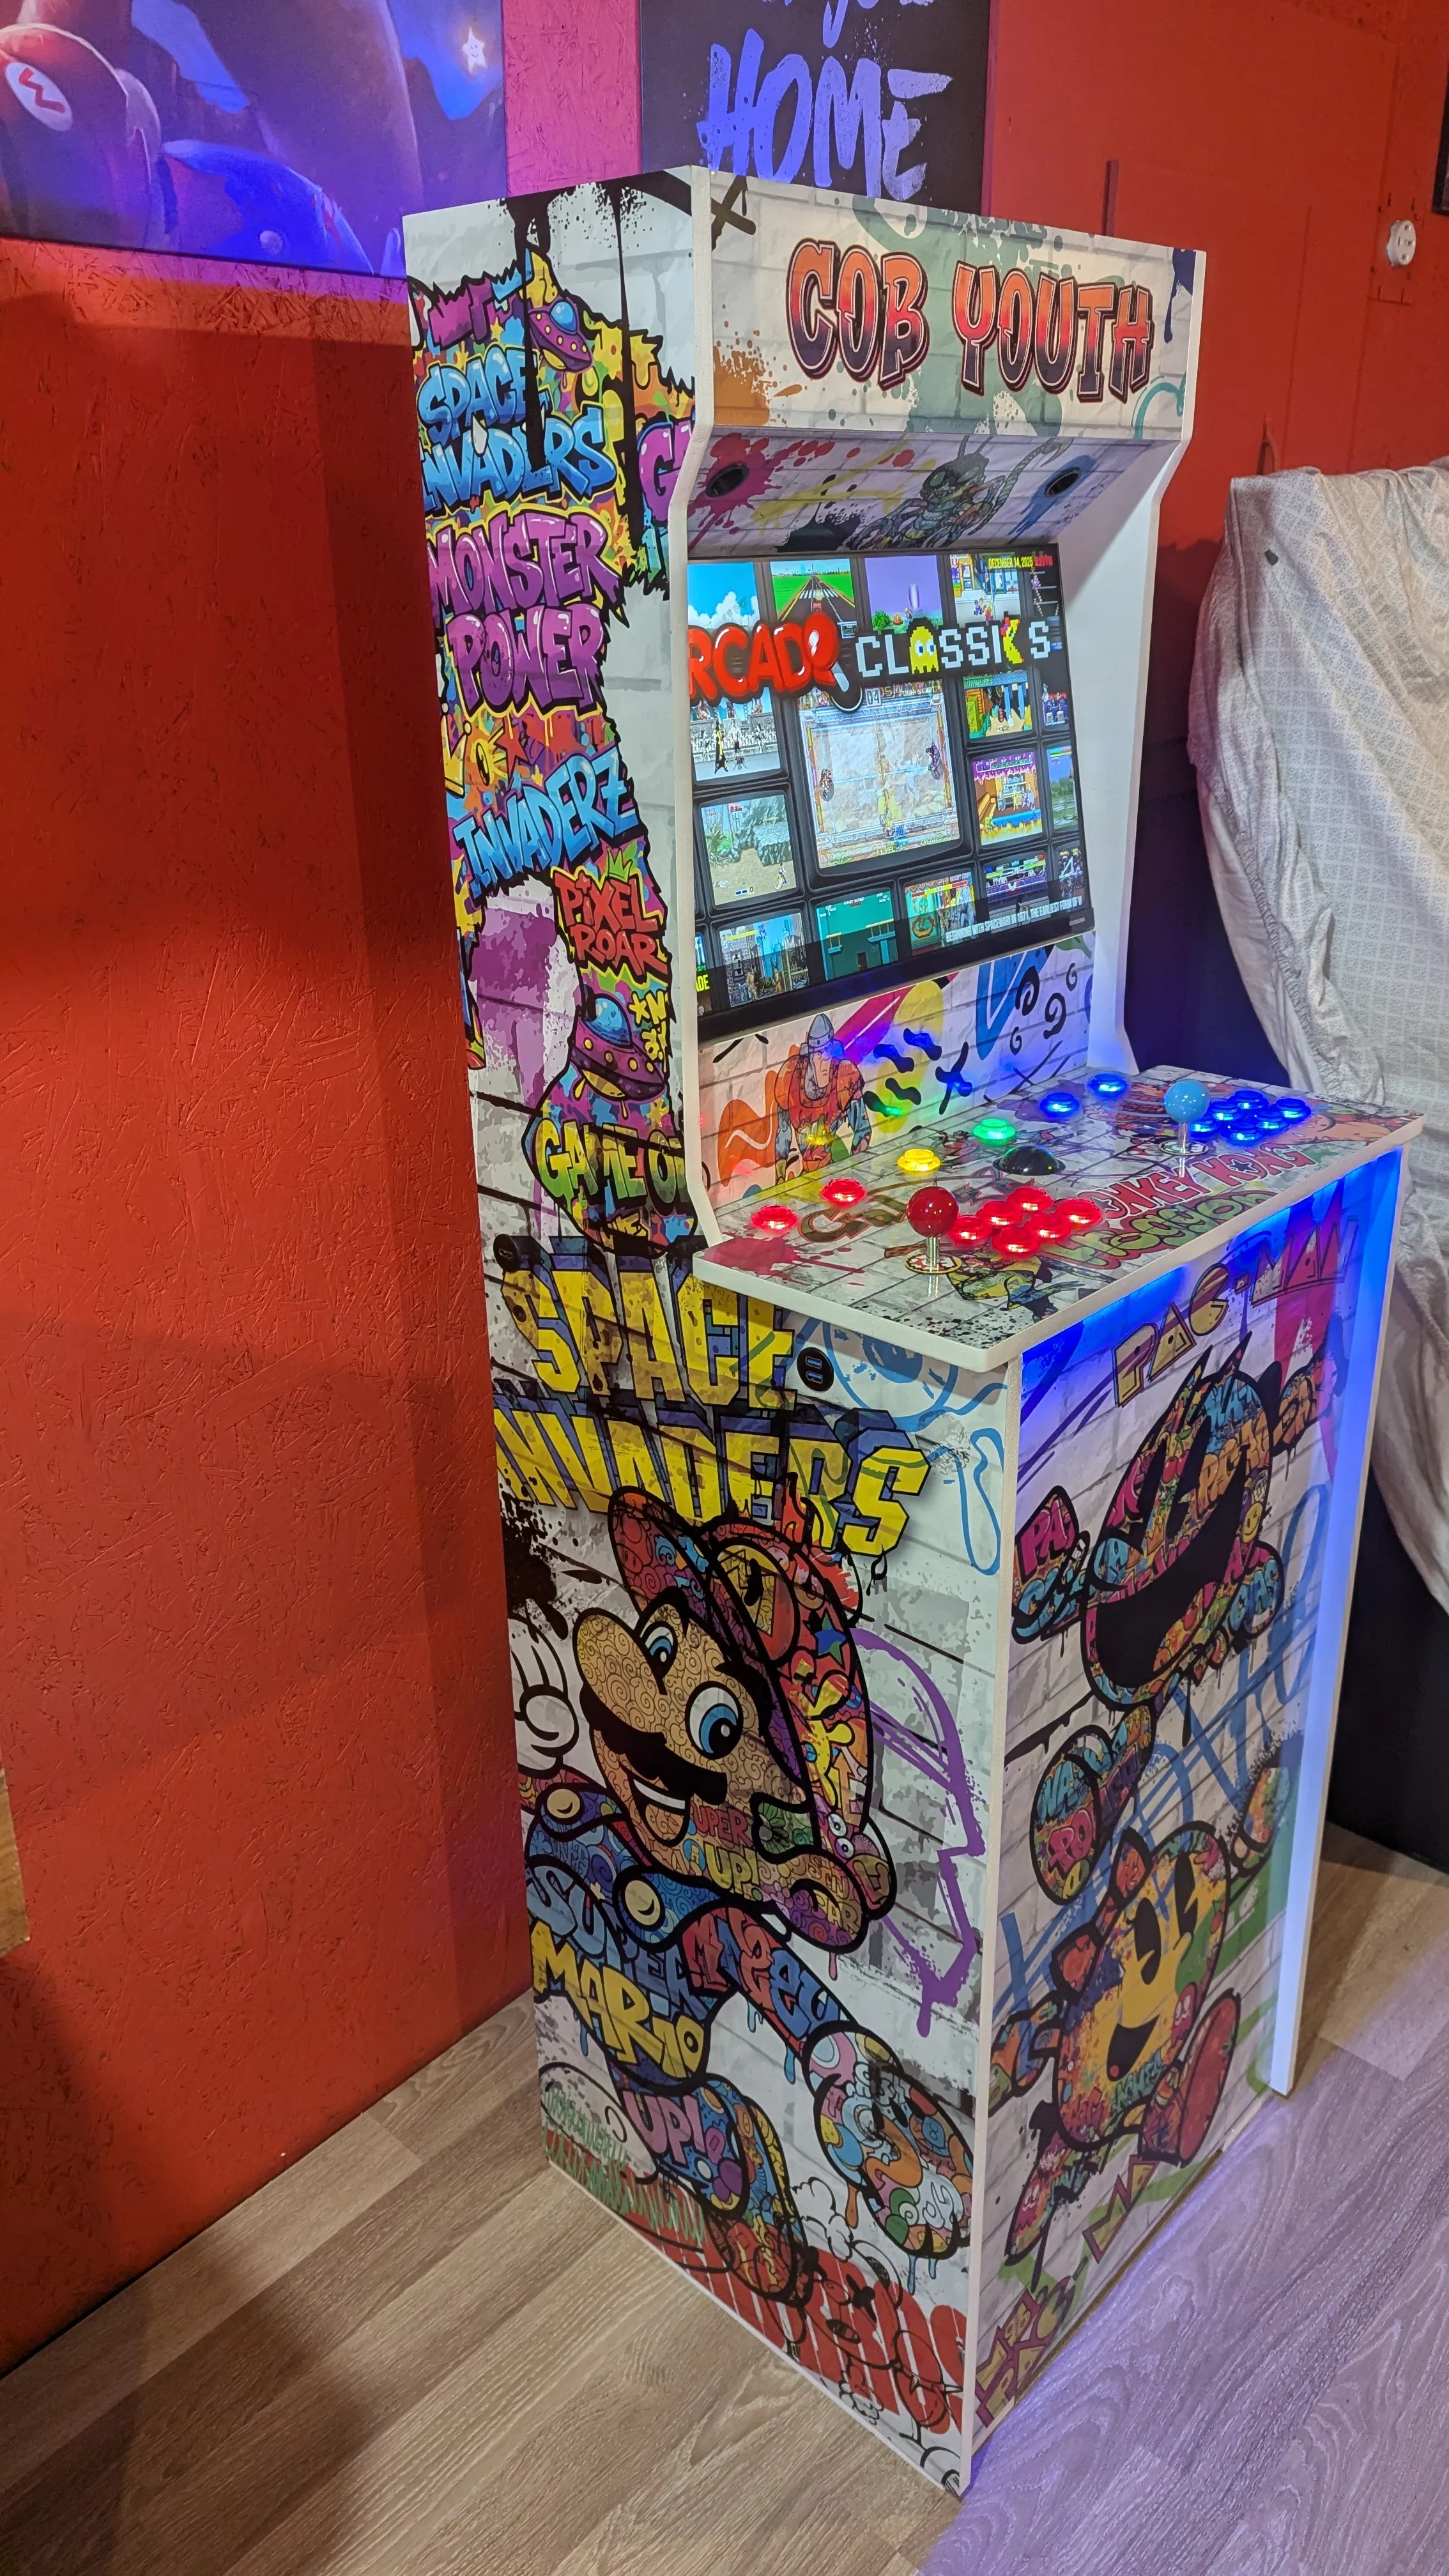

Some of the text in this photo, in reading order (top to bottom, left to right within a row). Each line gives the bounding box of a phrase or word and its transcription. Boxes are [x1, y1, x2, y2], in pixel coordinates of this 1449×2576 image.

[697, 29, 953, 201] HOME
[786, 238, 1154, 404] COB YOUTH
[427, 513, 620, 627] MONSTER
[988, 557, 1013, 569] DECEMBER
[1021, 556, 1034, 567] 2025
[447, 604, 604, 709] POWER
[571, 924, 668, 976] ROAR
[946, 925, 972, 943] BEGINNING
[972, 921, 985, 936] WITH
[1011, 912, 1017, 924] IN
[1030, 907, 1040, 919] THE
[1039, 901, 1059, 917] EARLIEST
[1059, 898, 1072, 912] FORM
[1057, 1165, 1212, 1220] ONKEY
[1192, 1142, 1318, 1188] KONG
[501, 1269, 797, 1410] SPACE
[1112, 1220, 1360, 1407] PAC-MAN
[530, 1920, 705, 2079] MARIO
